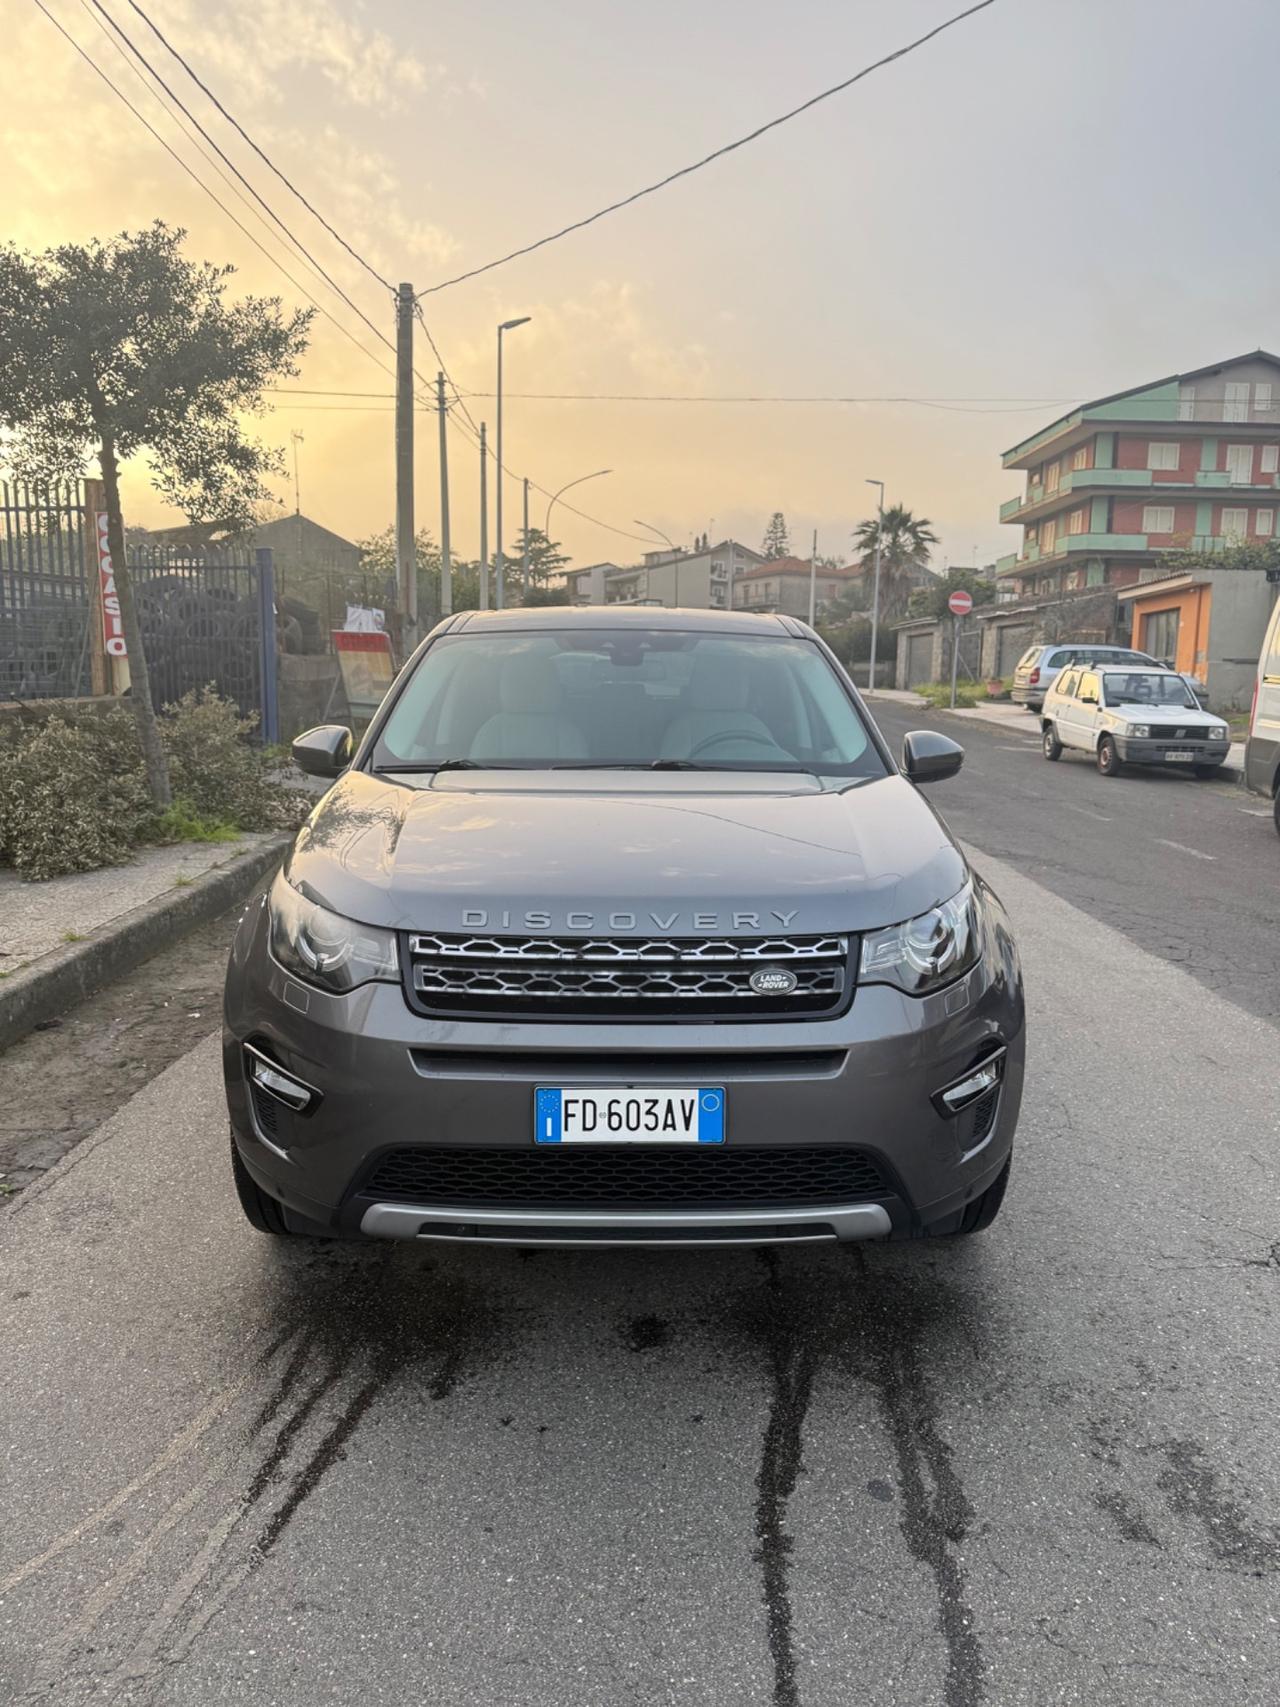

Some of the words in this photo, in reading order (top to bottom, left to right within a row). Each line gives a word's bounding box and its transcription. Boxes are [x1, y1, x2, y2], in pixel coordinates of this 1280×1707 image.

[462, 909, 799, 930] DISCOVERY
[760, 974, 783, 982] LAND
[762, 981, 789, 989] ROVER
